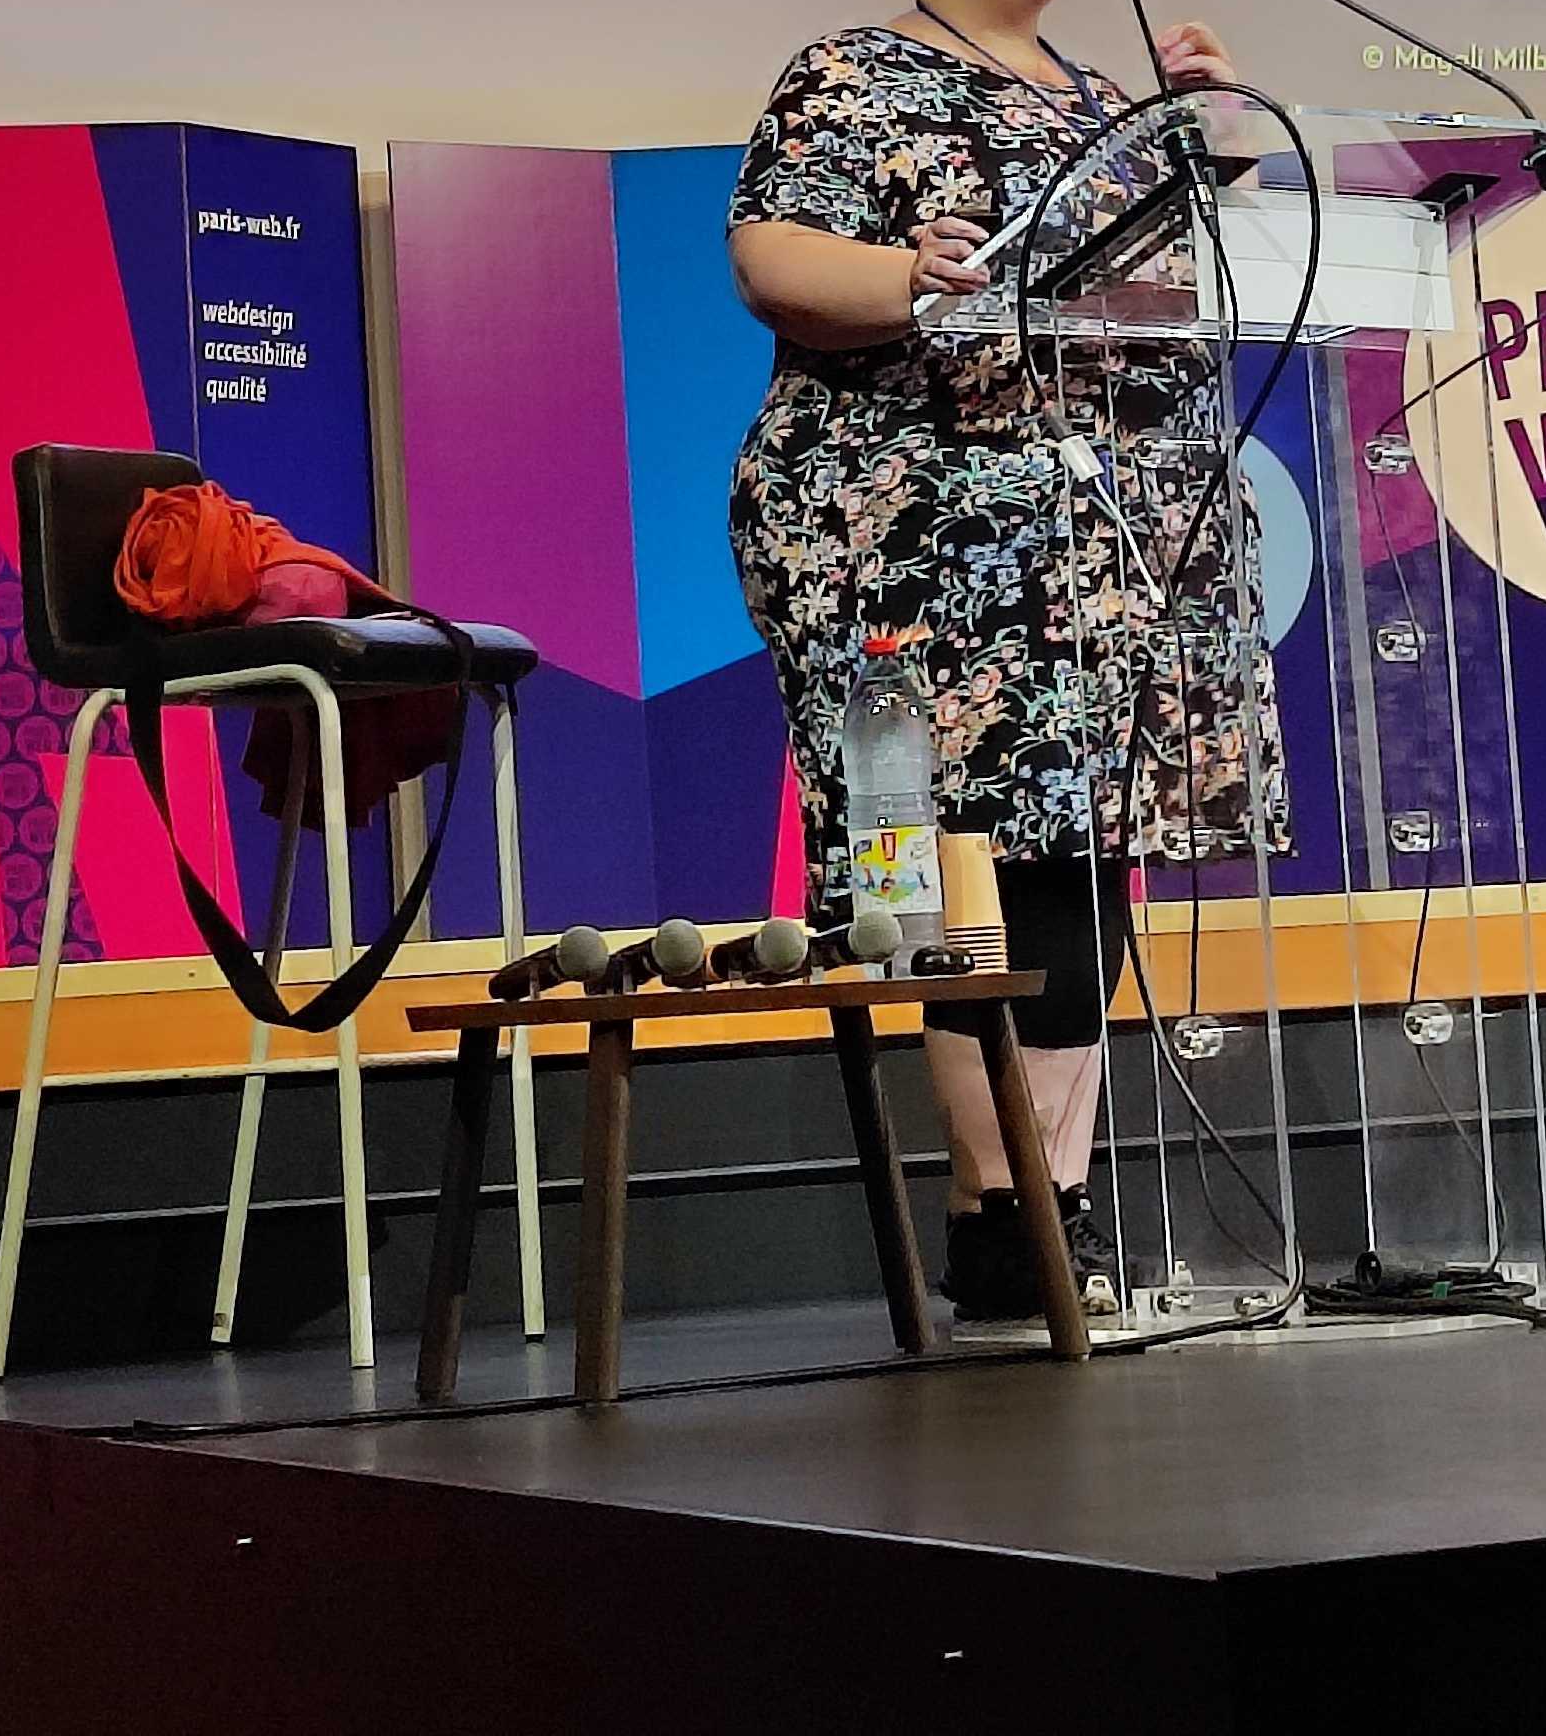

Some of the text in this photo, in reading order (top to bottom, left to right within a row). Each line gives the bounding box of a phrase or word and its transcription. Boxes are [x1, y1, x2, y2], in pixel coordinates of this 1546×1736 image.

[198, 208, 301, 240] paris-web.fr
[202, 299, 294, 335] webdesign
[204, 341, 307, 369] accessibilité
[206, 375, 267, 404] qualité
